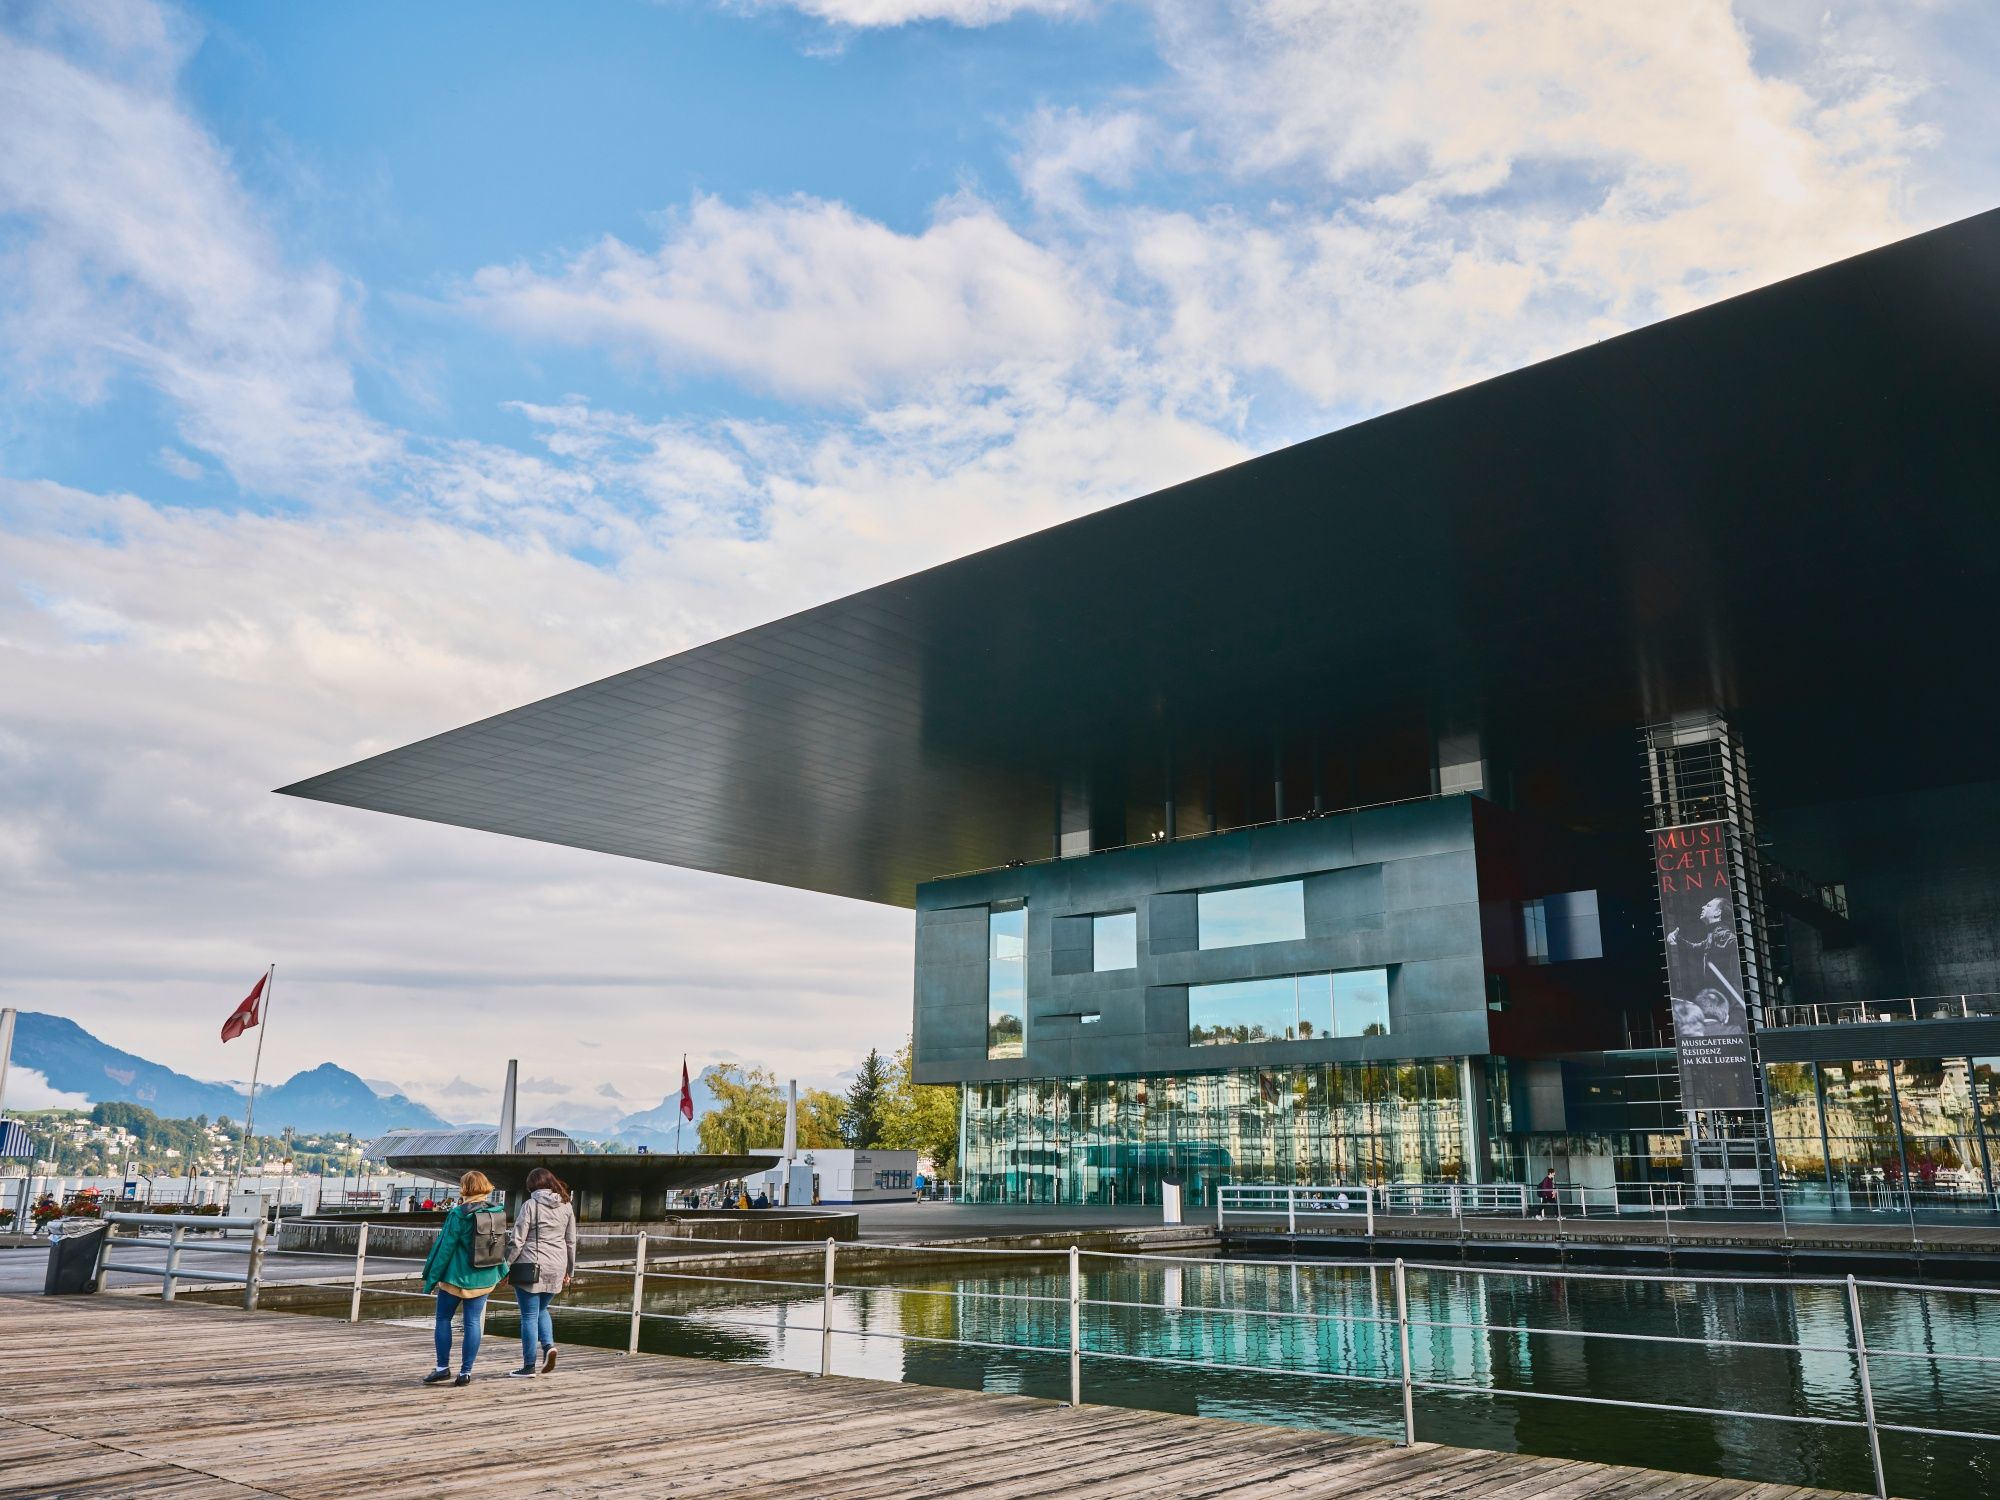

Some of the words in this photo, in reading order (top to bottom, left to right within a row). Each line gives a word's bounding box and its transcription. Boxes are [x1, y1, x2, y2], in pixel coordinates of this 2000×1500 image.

[1658, 826, 1721, 849] MUSI
[1659, 848, 1724, 871] CÆTE
[1695, 1057, 1713, 1065] KKL
[131, 1164, 136, 1172] 5
